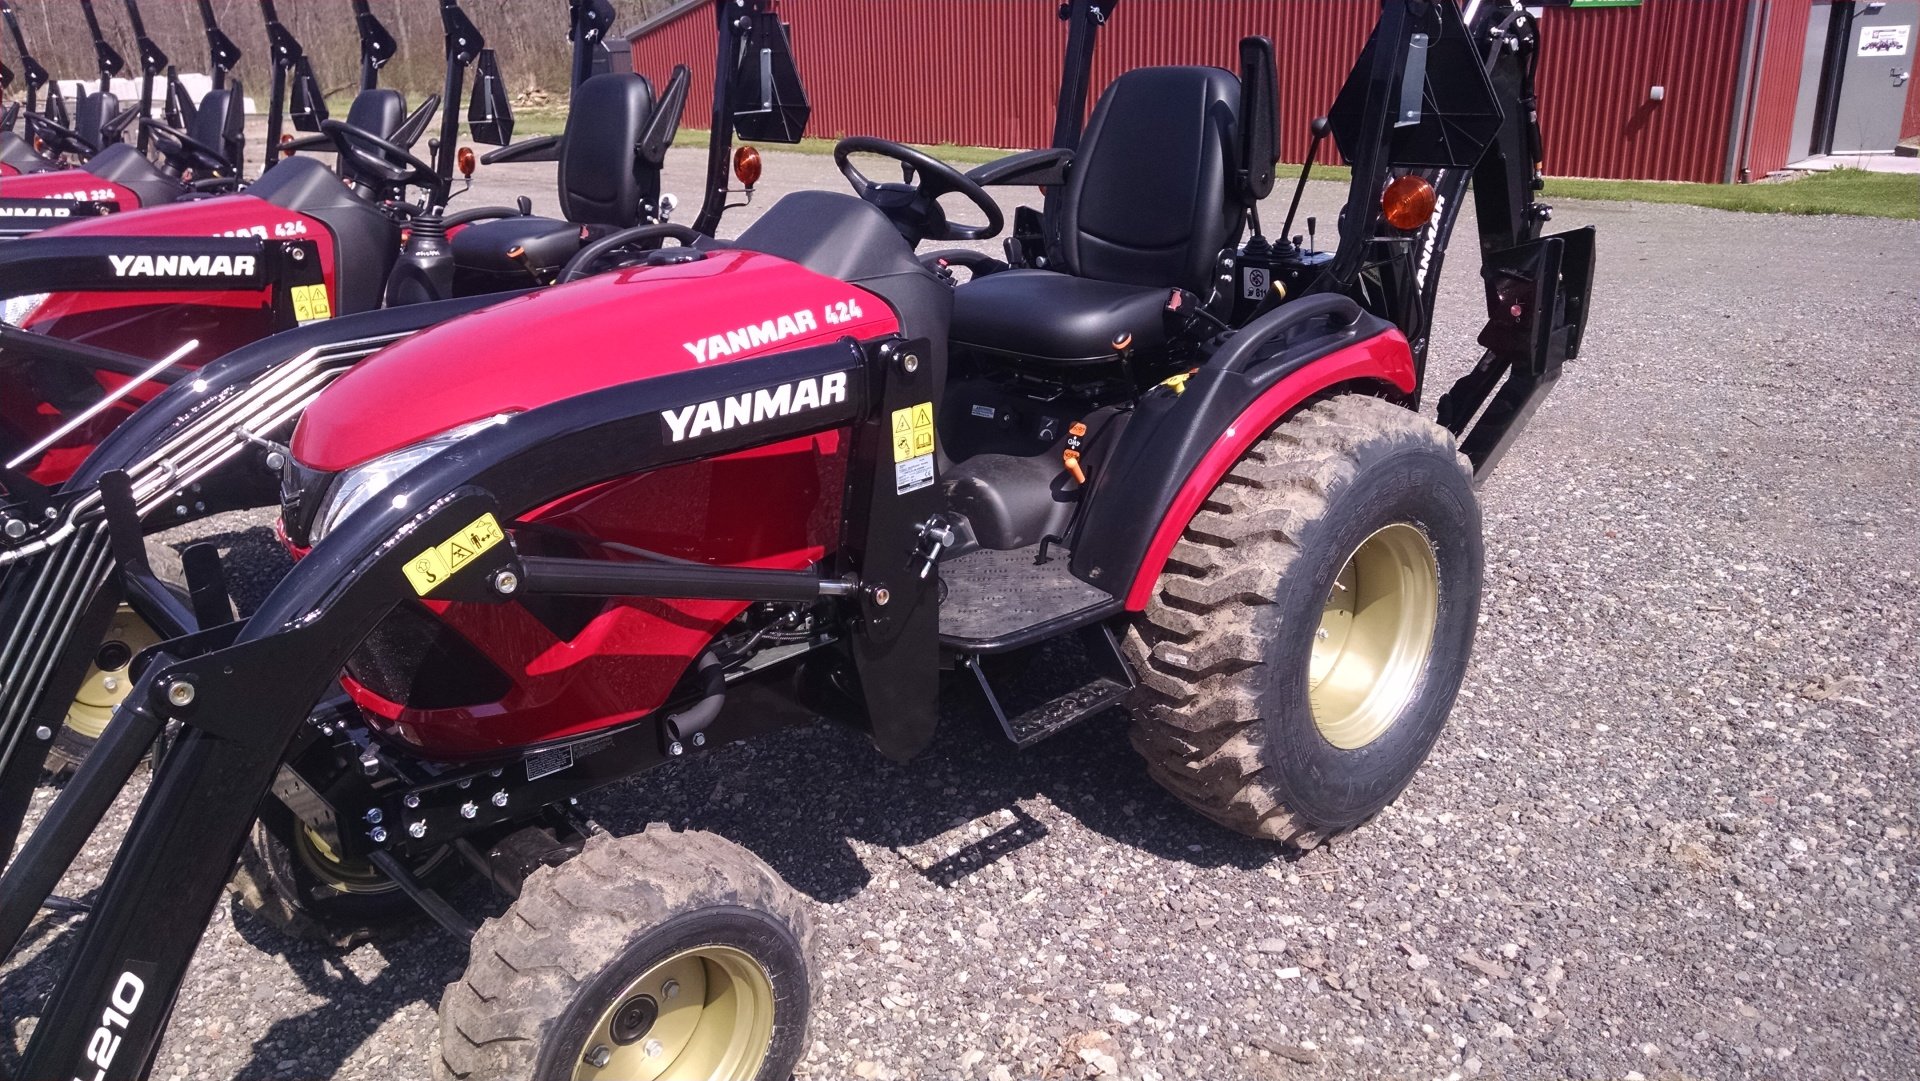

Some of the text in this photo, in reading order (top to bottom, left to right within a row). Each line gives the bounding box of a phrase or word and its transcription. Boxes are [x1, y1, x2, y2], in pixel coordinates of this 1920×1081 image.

[90, 188, 115, 201] 324
[274, 220, 307, 237] 424
[1417, 194, 1446, 296] ANMAR
[109, 255, 256, 277] YANMAR
[683, 298, 863, 364] YANMAR 424
[661, 371, 847, 443] YANMAR
